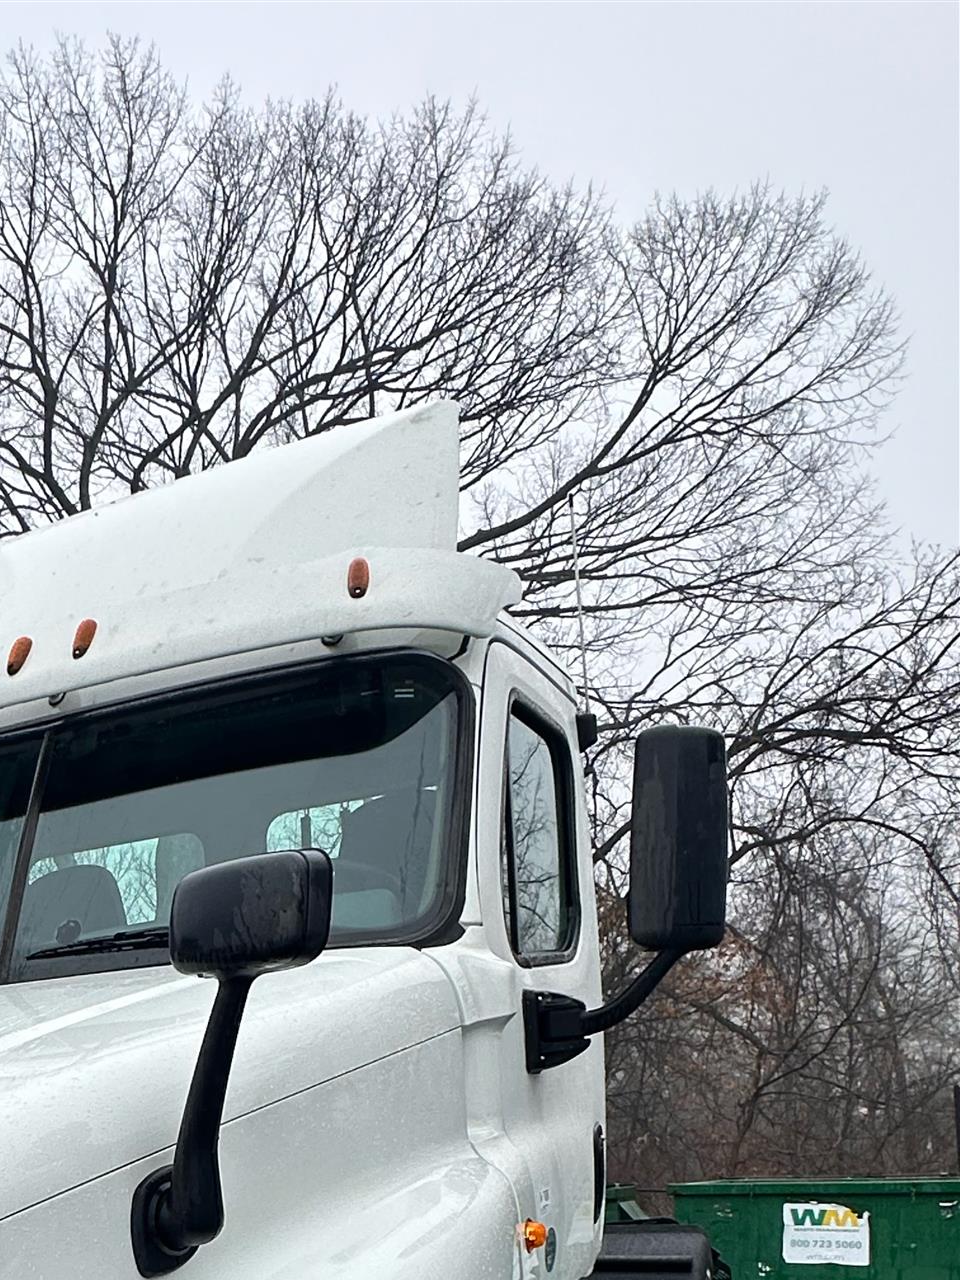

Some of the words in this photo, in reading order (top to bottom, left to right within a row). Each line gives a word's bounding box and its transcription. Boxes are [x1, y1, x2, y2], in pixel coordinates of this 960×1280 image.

[790, 1208, 859, 1227] WM
[790, 1239, 810, 1248] 800
[812, 1239, 832, 1248] 723
[835, 1240, 862, 1249] 5060
